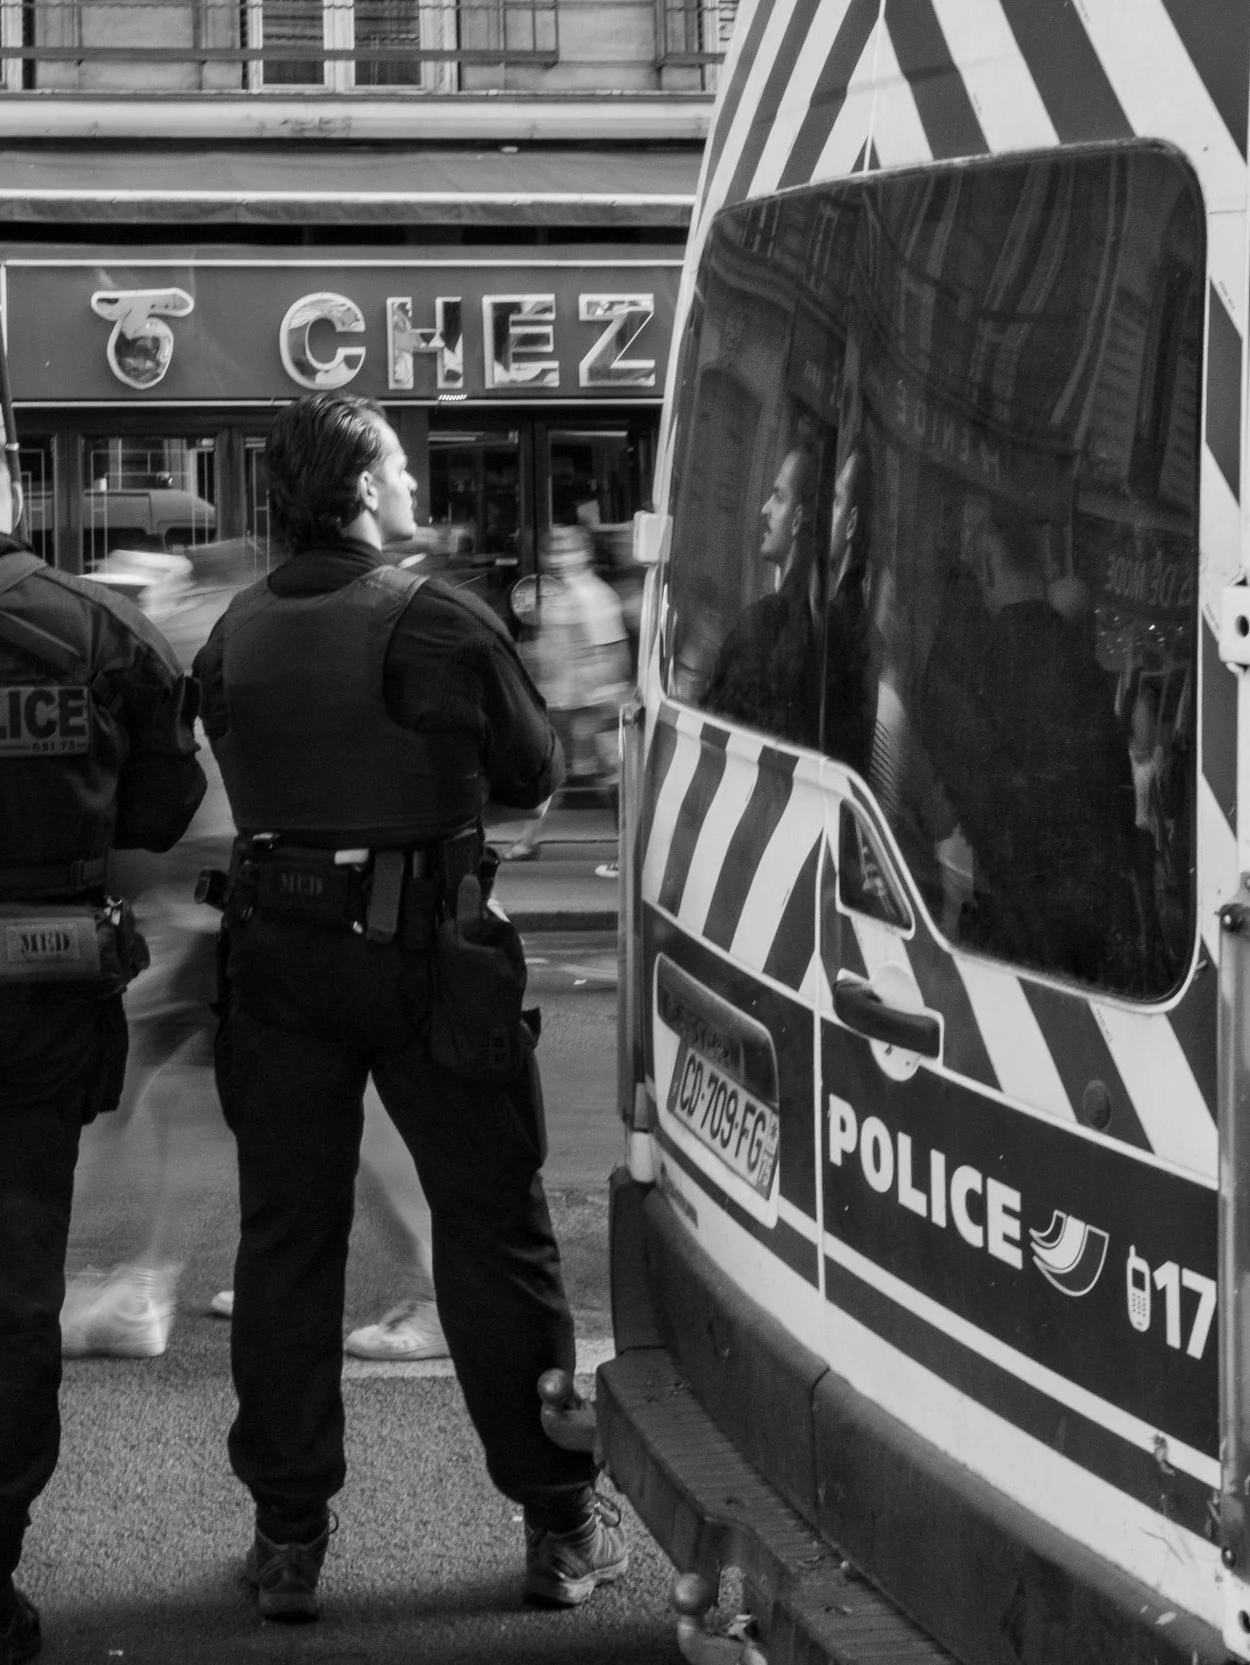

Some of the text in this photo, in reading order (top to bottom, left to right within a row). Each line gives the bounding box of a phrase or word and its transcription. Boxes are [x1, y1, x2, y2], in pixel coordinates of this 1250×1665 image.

[279, 291, 656, 391] CHEZ
[20, 932, 71, 954] MED
[827, 1093, 1024, 1270] POLICE
[1155, 1260, 1217, 1360] 17
